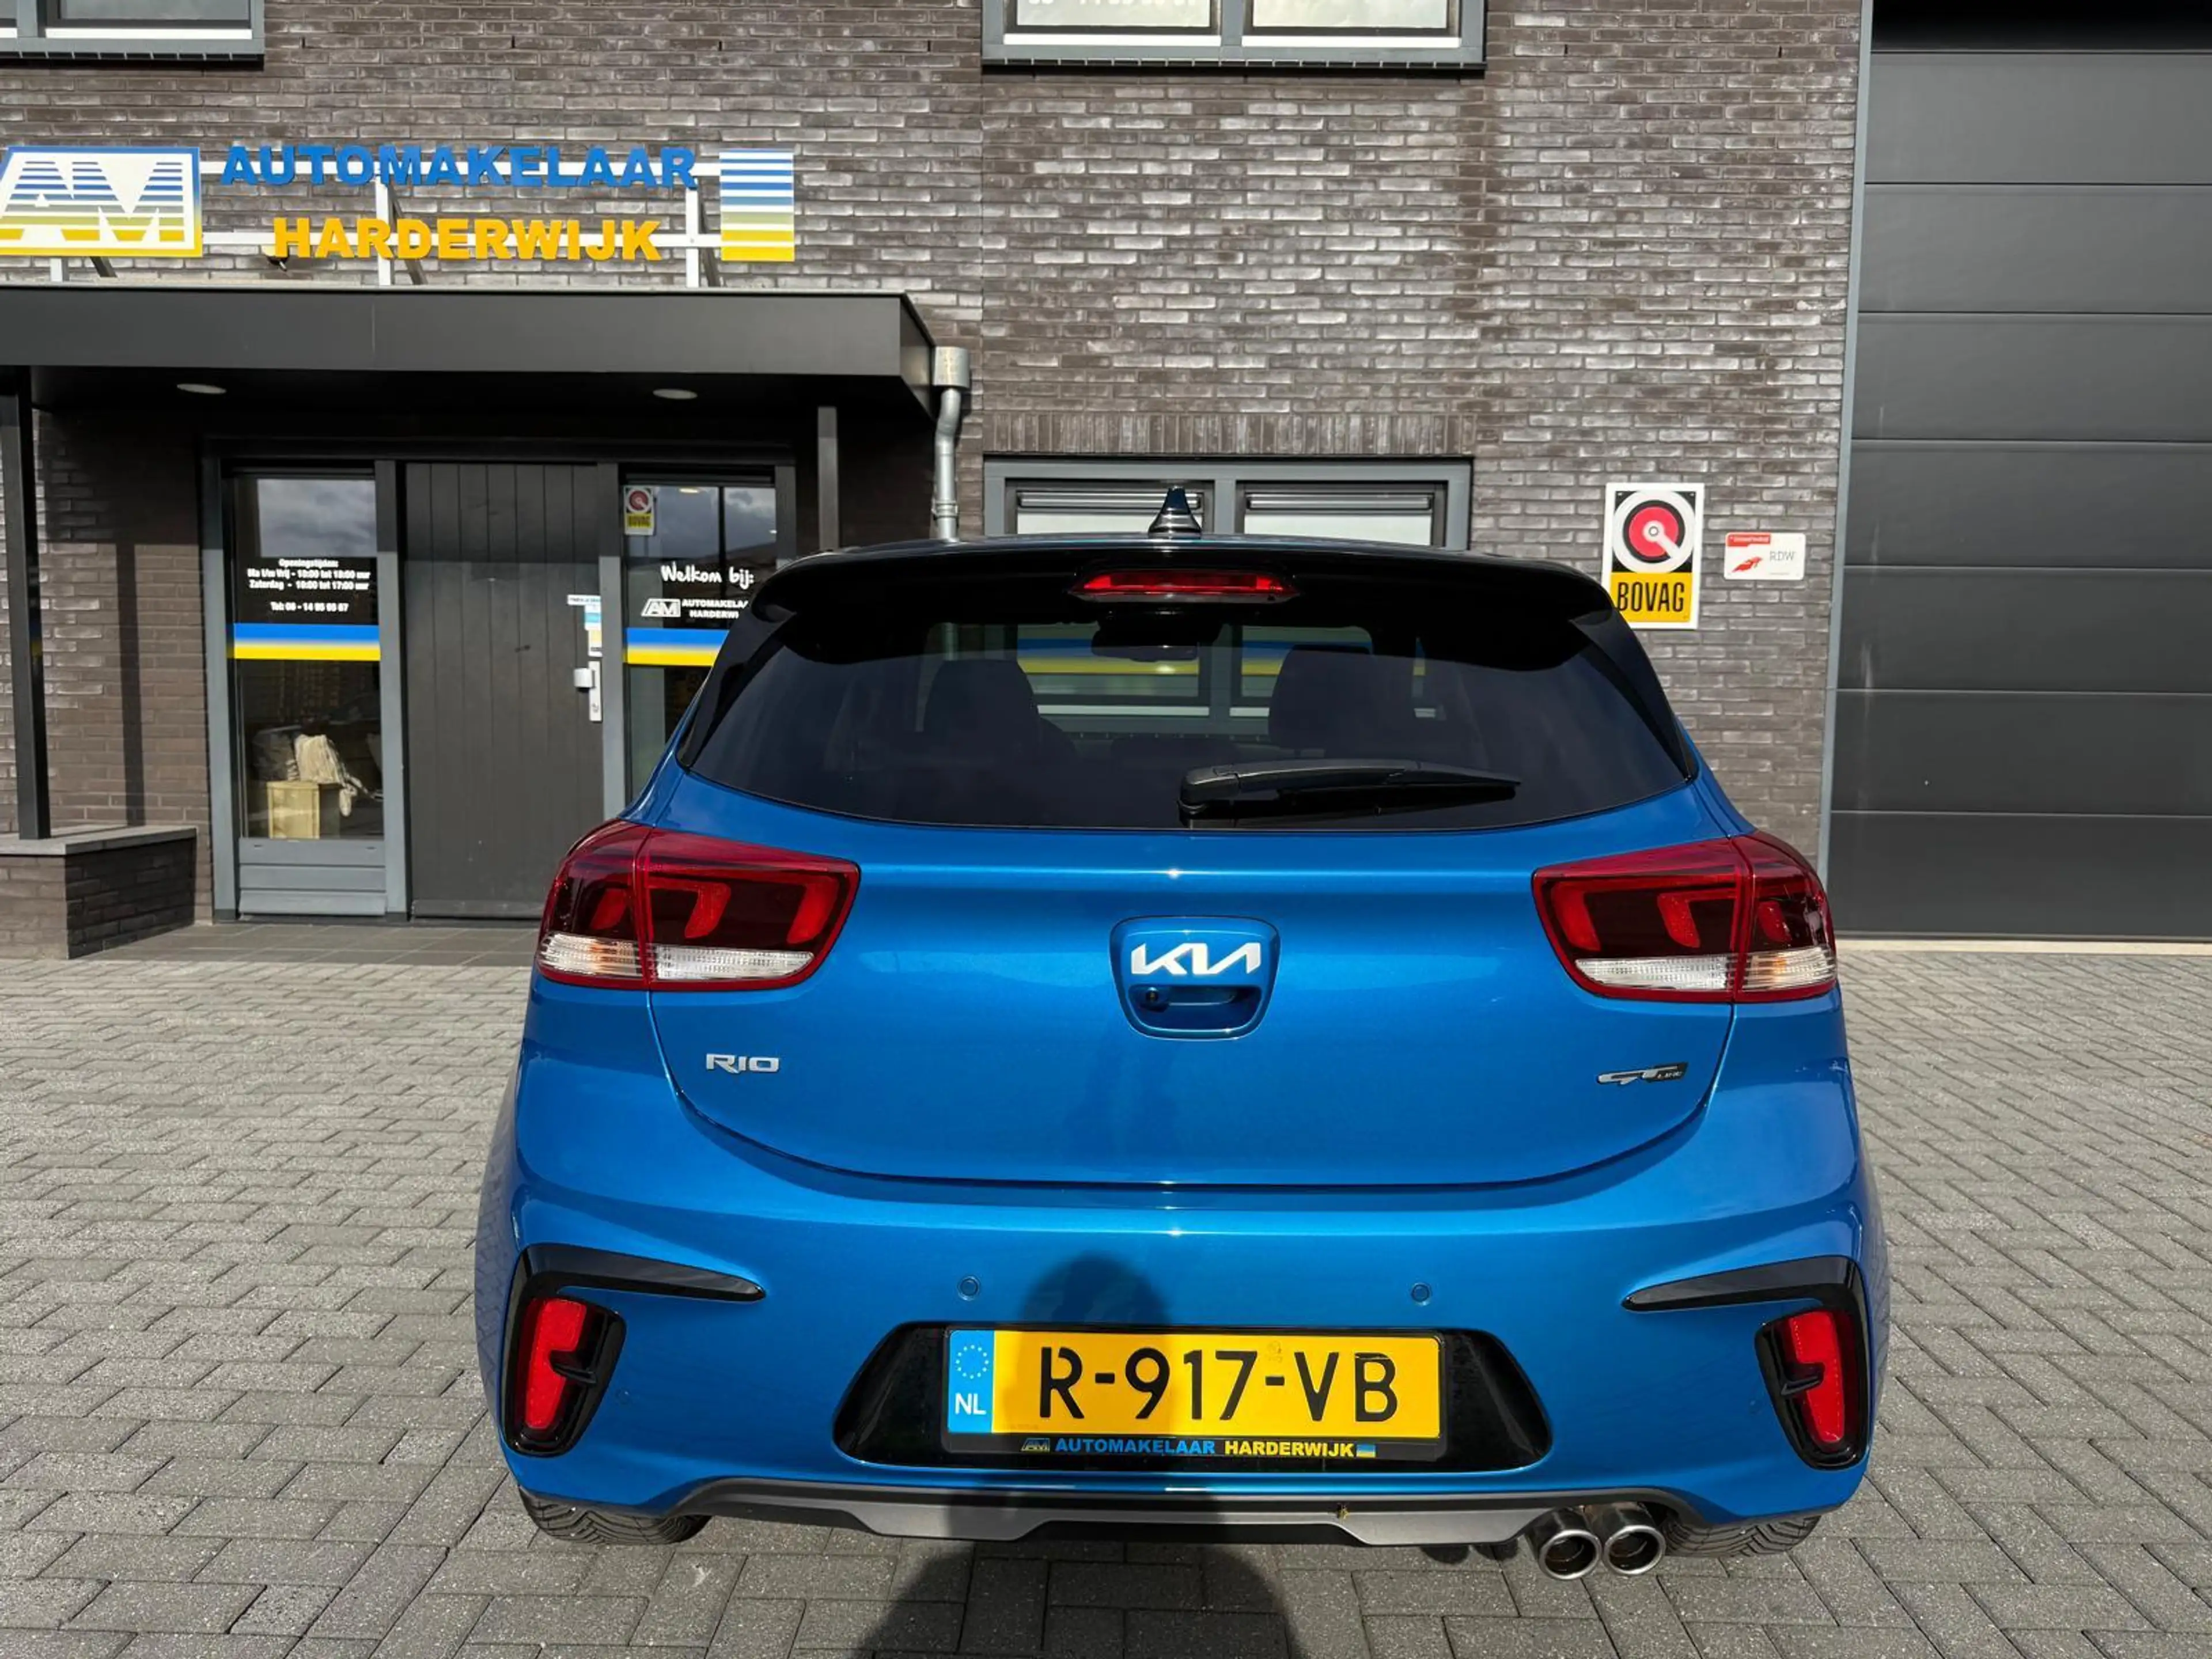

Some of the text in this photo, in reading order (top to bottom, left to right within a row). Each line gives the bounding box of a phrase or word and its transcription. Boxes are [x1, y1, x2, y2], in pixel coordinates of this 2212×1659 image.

[219, 145, 697, 189] AUTOMAKELAAR
[273, 217, 662, 260] HARDERWIJK
[1769, 550, 1796, 561] RDW
[660, 560, 754, 590] Welkom bij:
[681, 599, 748, 608] AUTOMAKELA
[1617, 581, 1685, 613] BOVAG
[1131, 942, 1262, 975] KIA
[706, 1053, 779, 1074] RIO
[1039, 1346, 1399, 1423] R-917-VB
[954, 1393, 987, 1416] NL
[1055, 1439, 1216, 1455] AUTOMAKELAAR
[1224, 1440, 1355, 1457] HARDERWIJK
